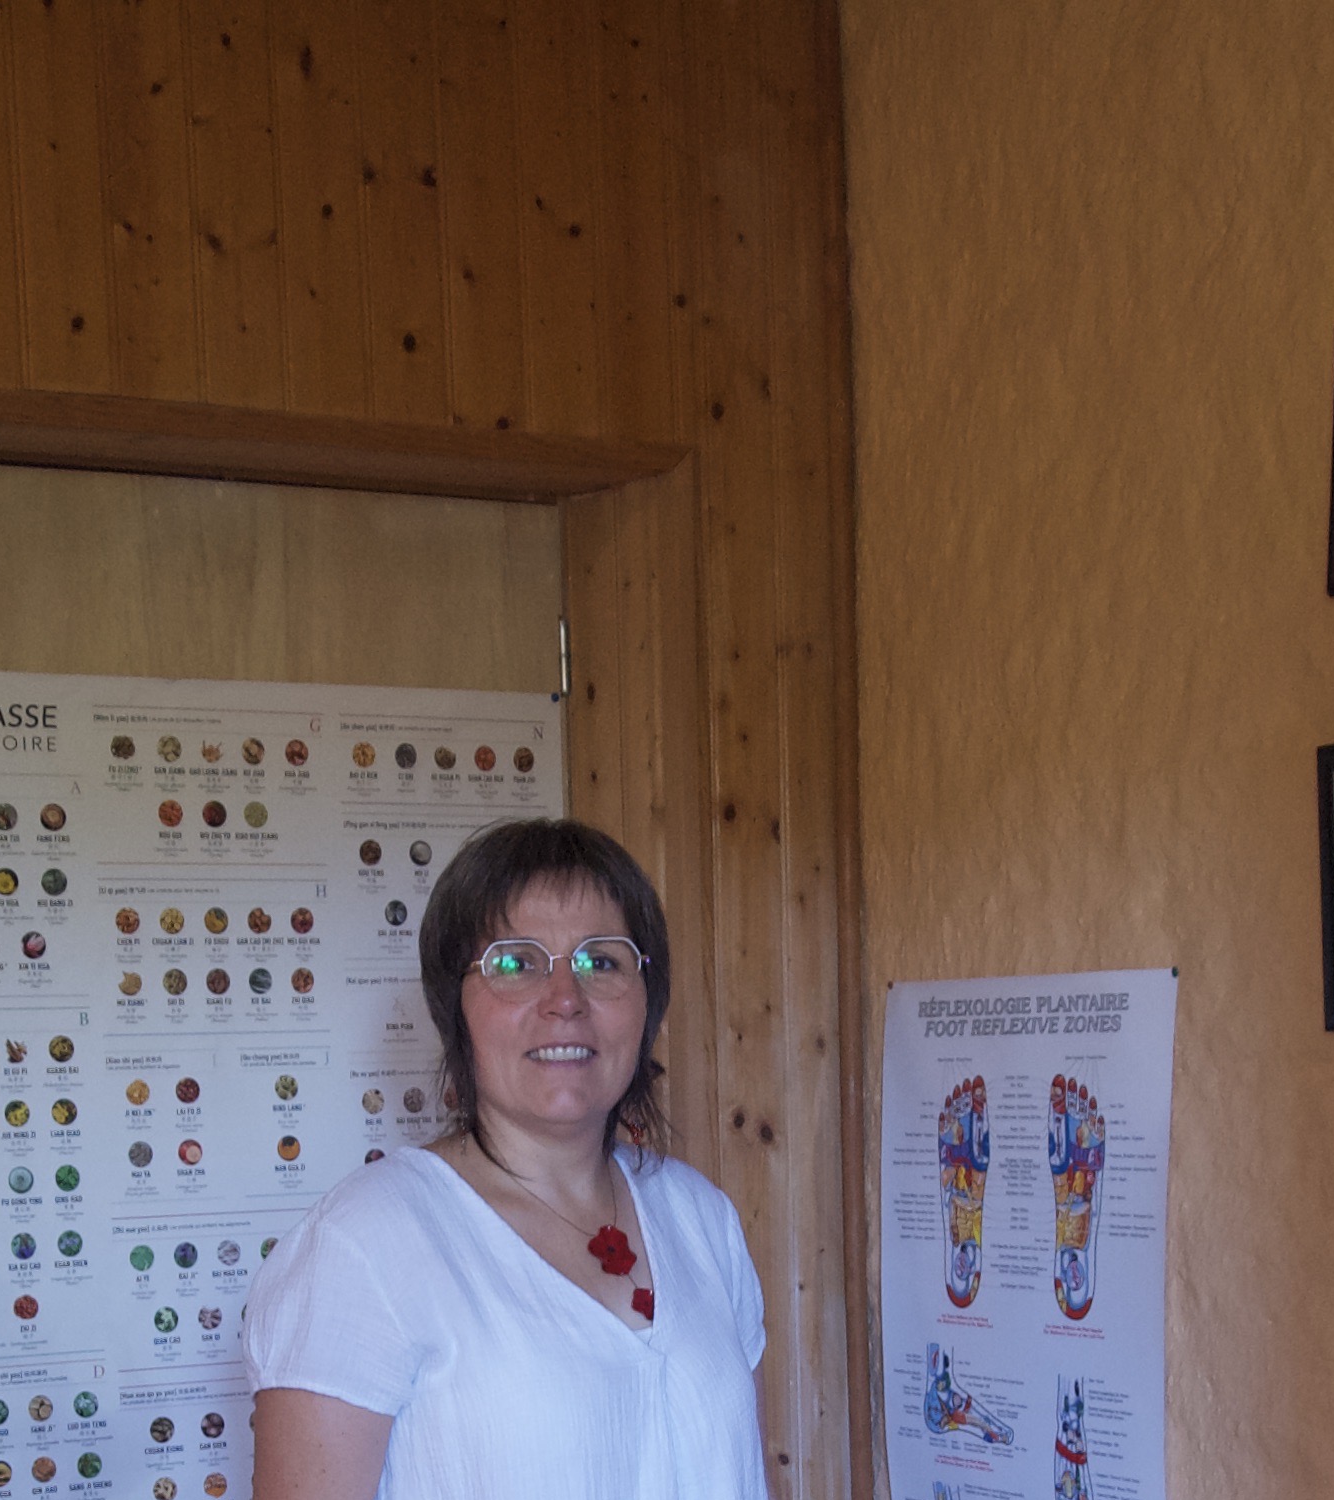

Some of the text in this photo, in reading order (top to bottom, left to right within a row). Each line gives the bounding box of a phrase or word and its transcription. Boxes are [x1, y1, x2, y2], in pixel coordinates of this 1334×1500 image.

[533, 727, 543, 740] N
[315, 884, 327, 898] H
[918, 992, 1129, 1018] RÉFLEXOLOGIE PLANTAIRE
[79, 1012, 89, 1026] B
[925, 1014, 1122, 1037] FOOT REFLEXIVE ZONES
[94, 1364, 105, 1378] D
